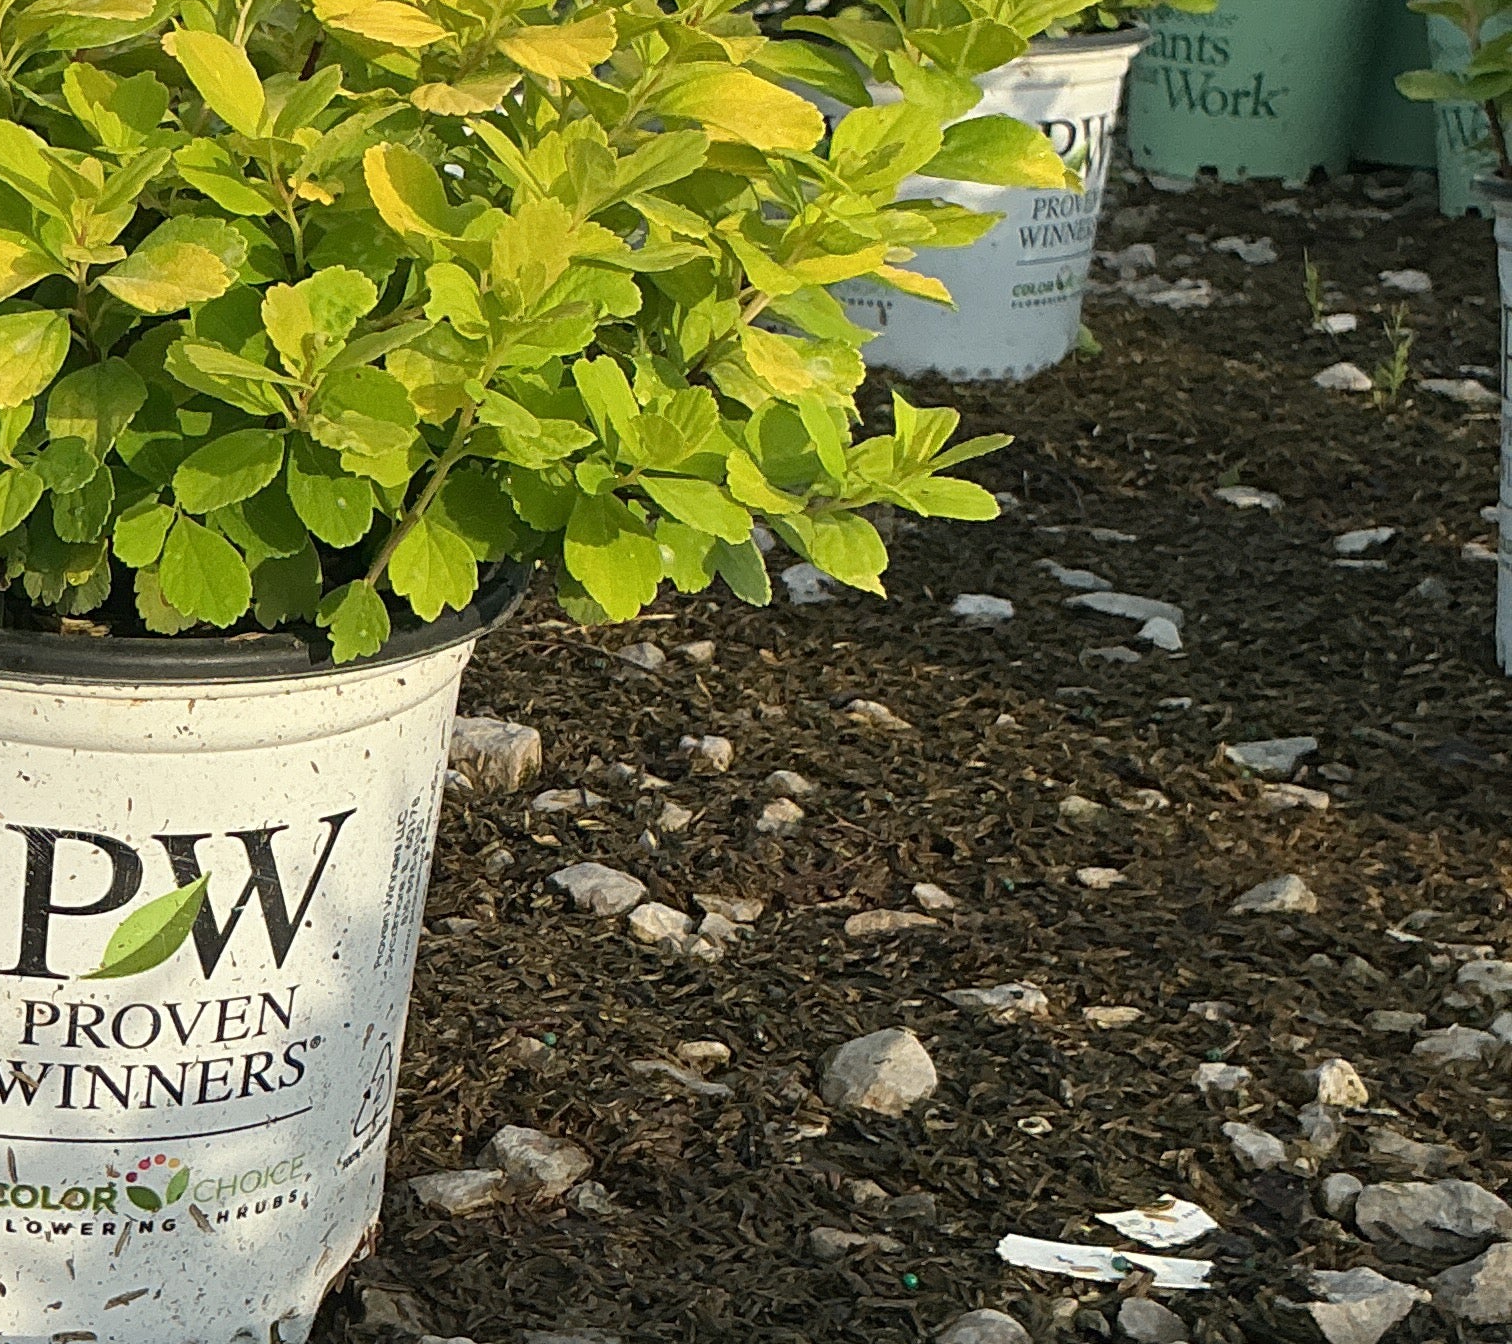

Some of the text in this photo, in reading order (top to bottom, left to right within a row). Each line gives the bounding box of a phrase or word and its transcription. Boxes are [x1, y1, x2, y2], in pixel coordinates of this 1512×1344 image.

[1145, 31, 1230, 68] ants
[1160, 67, 1279, 119] Work
[18, 984, 301, 1049] PROVEN
[193, 1153, 305, 1204] CHOICE
[194, 1188, 298, 1228] HRUBS
